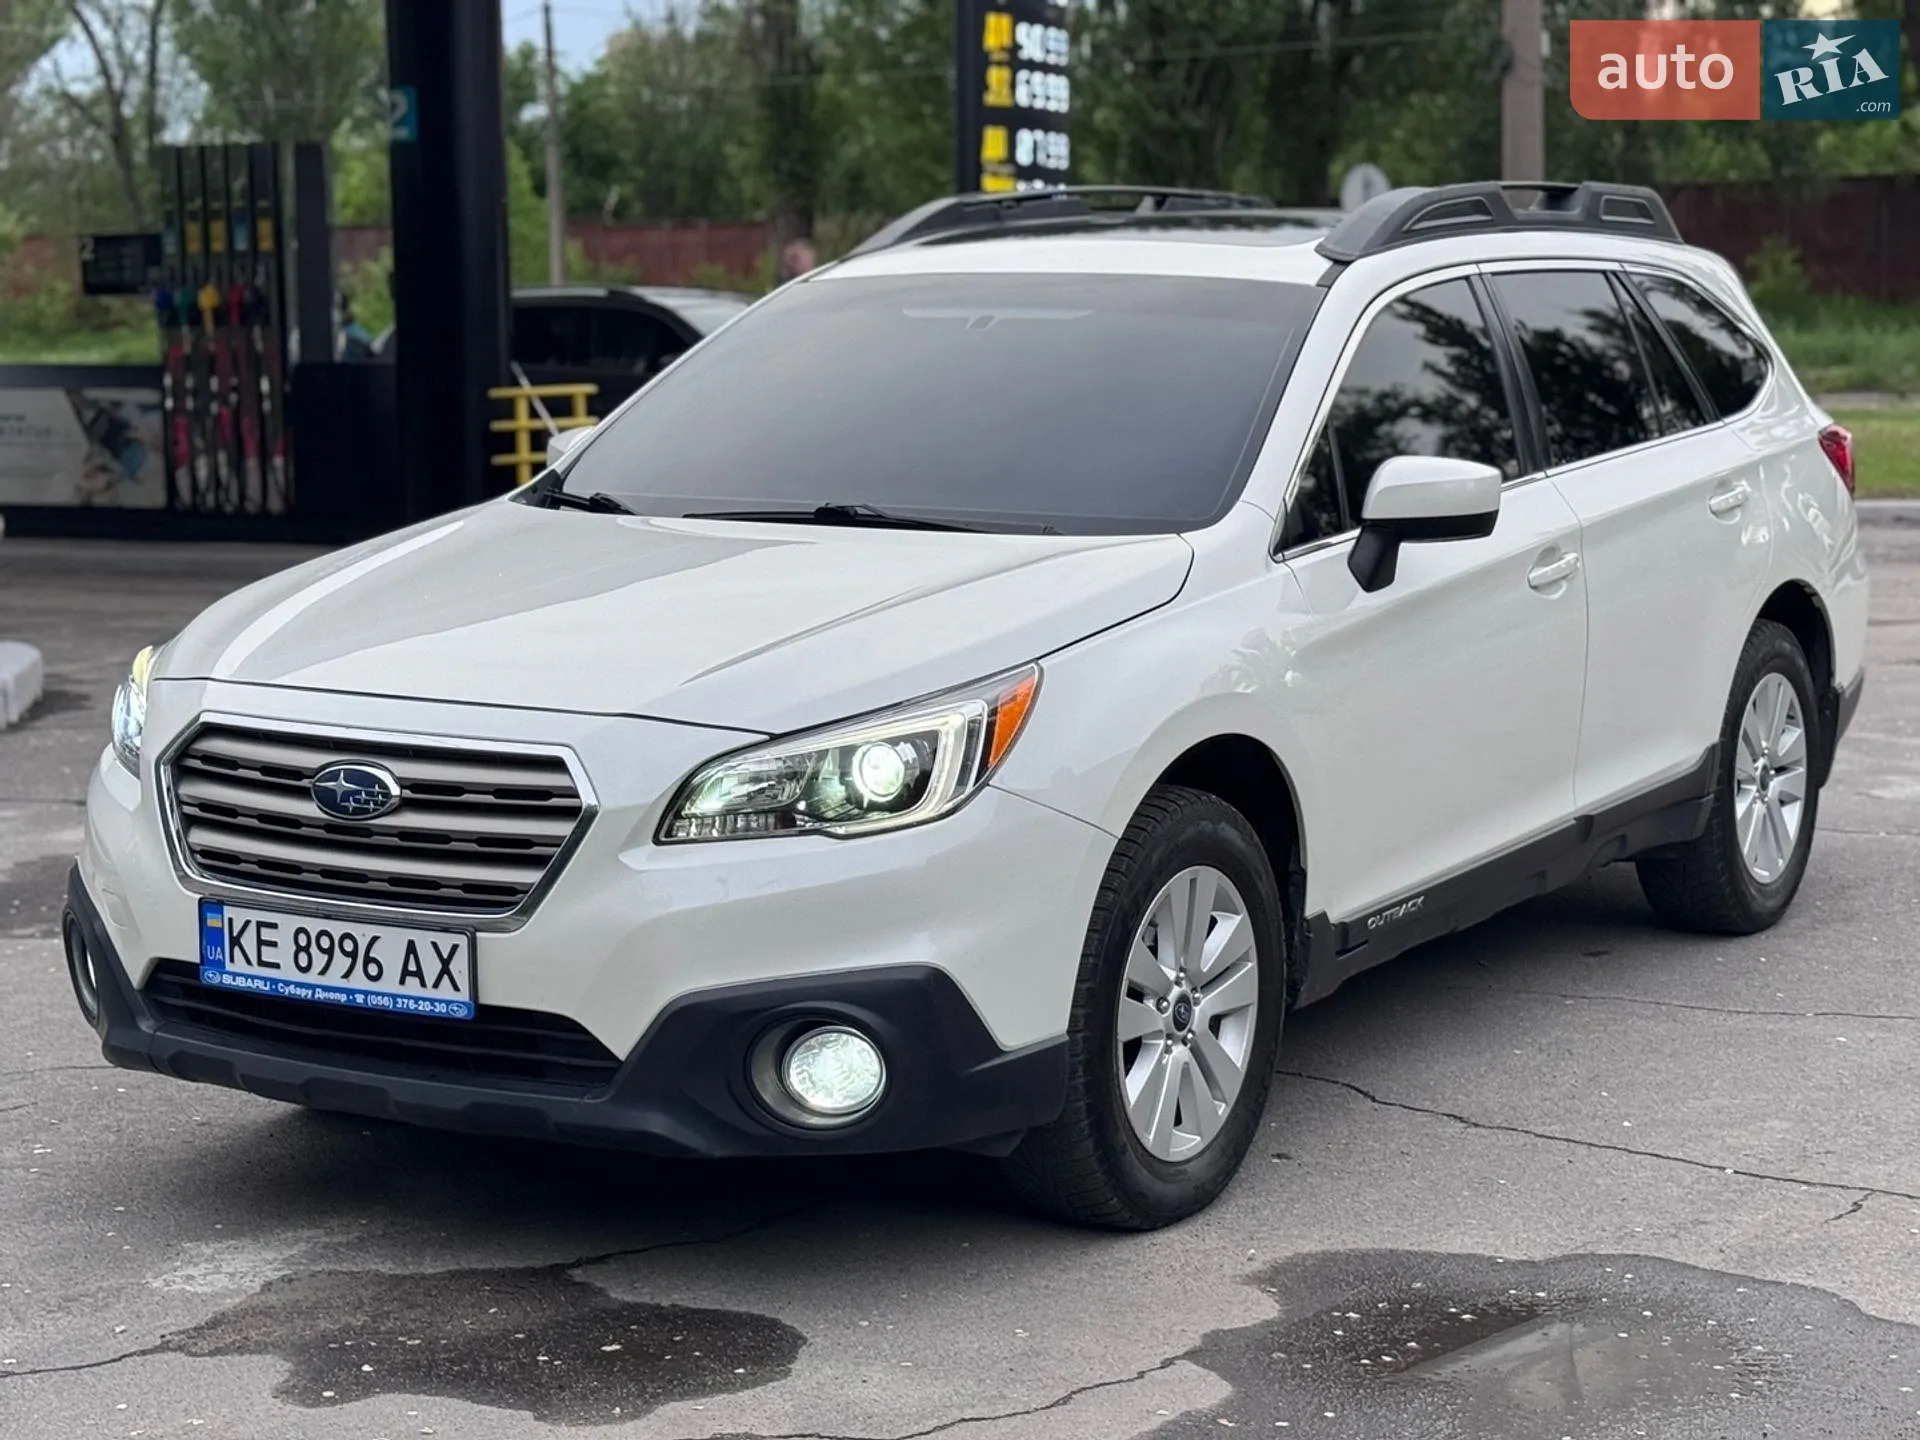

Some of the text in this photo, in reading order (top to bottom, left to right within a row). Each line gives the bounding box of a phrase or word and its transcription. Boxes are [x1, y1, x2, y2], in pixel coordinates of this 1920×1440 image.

[206, 946, 224, 963] UA
[227, 916, 461, 992] KE 8996 AX
[222, 974, 447, 1013] SUBARU Субару Днепр (056) 376-20-30
